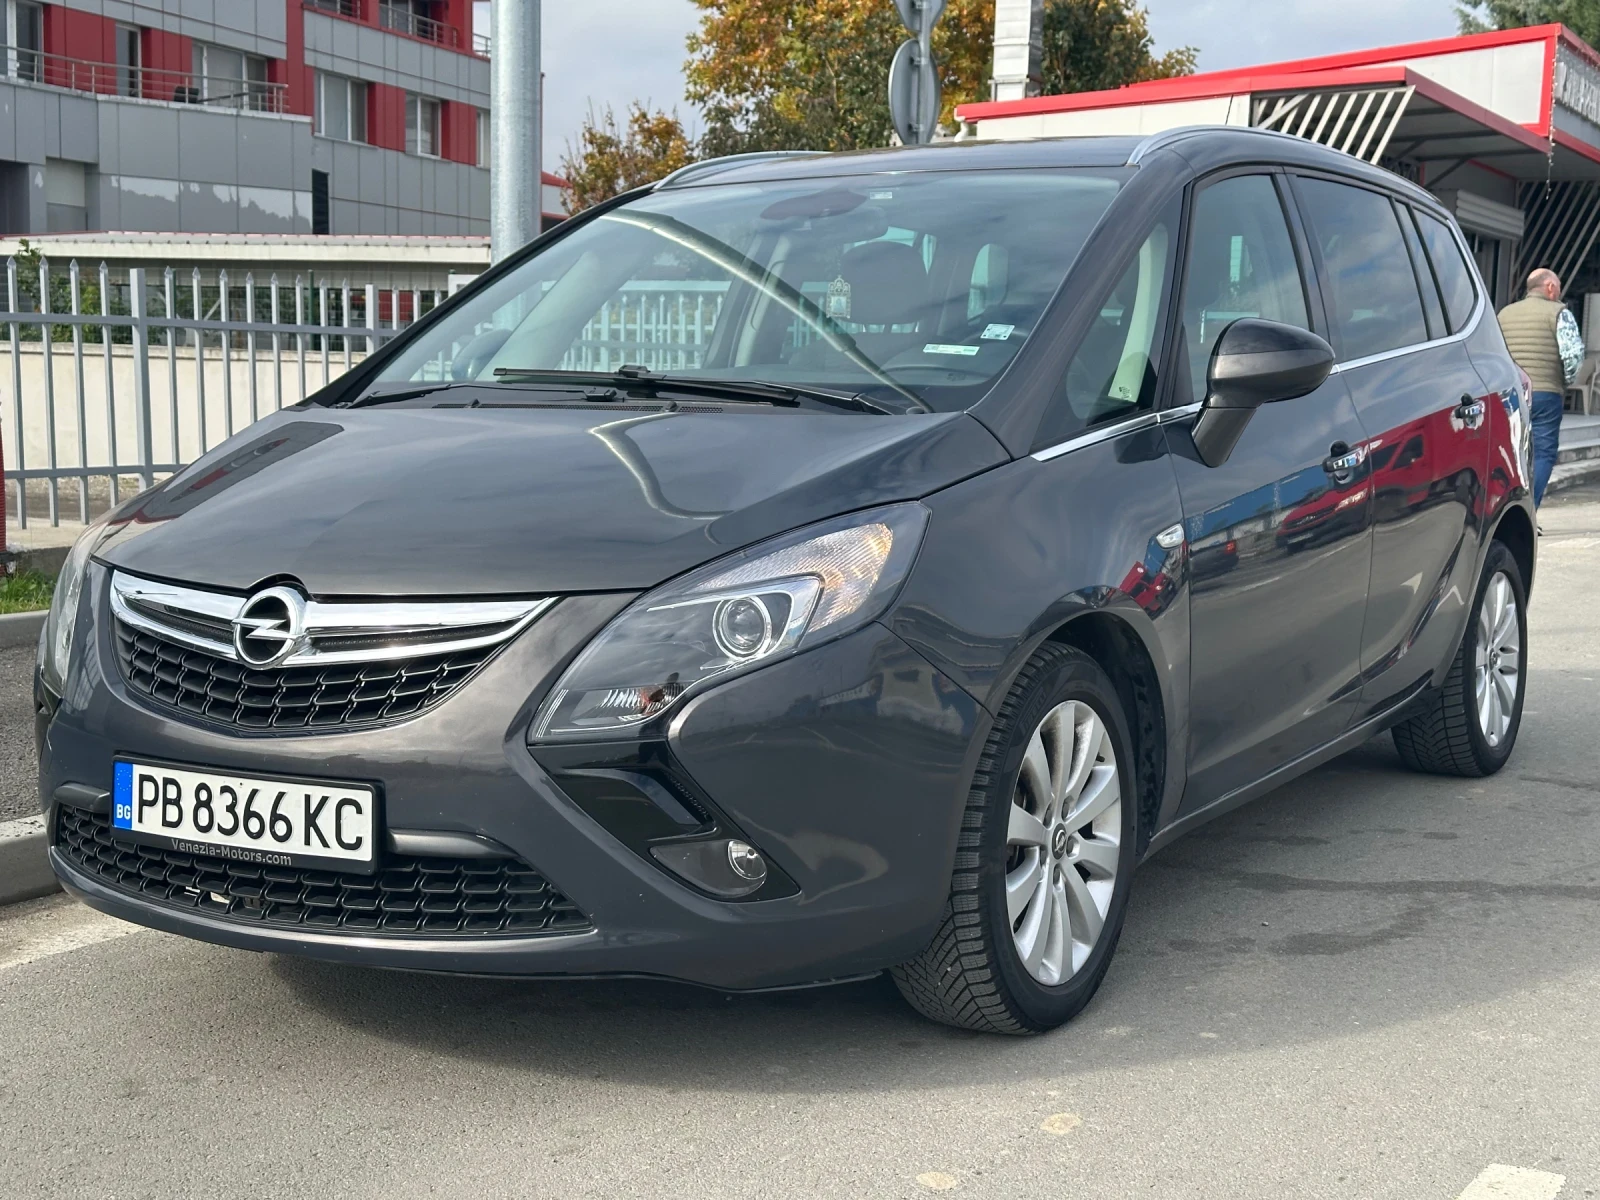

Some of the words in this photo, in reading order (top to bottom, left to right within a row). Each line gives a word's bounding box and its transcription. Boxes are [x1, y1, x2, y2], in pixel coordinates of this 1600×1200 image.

[116, 803, 131, 820] BG
[138, 773, 183, 829] PB
[193, 782, 293, 843] 8366
[303, 793, 363, 851] KC
[171, 838, 292, 866] Venezia-Motors.com
